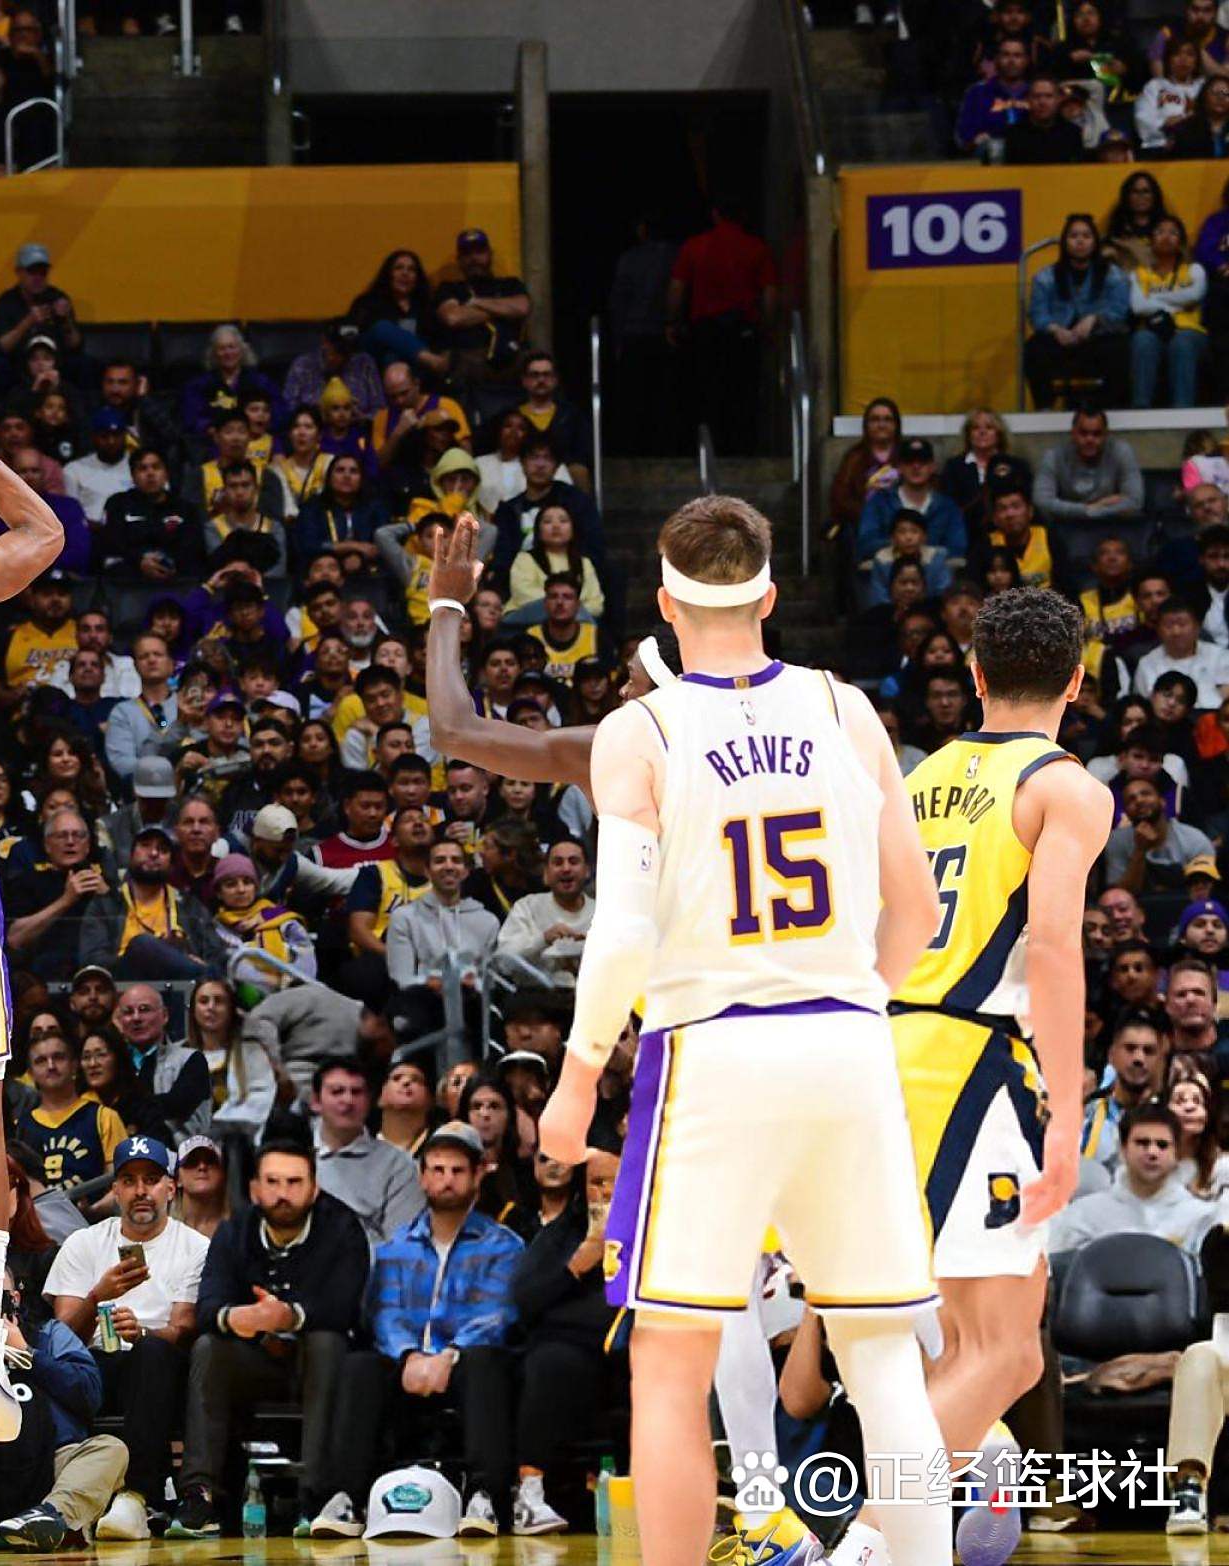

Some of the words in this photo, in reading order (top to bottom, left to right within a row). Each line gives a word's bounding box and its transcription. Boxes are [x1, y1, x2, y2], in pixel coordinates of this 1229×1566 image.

[882, 202, 1008, 257] 106
[705, 735, 814, 787] REAVES
[722, 809, 834, 943] 15
[928, 845, 968, 950] 6
